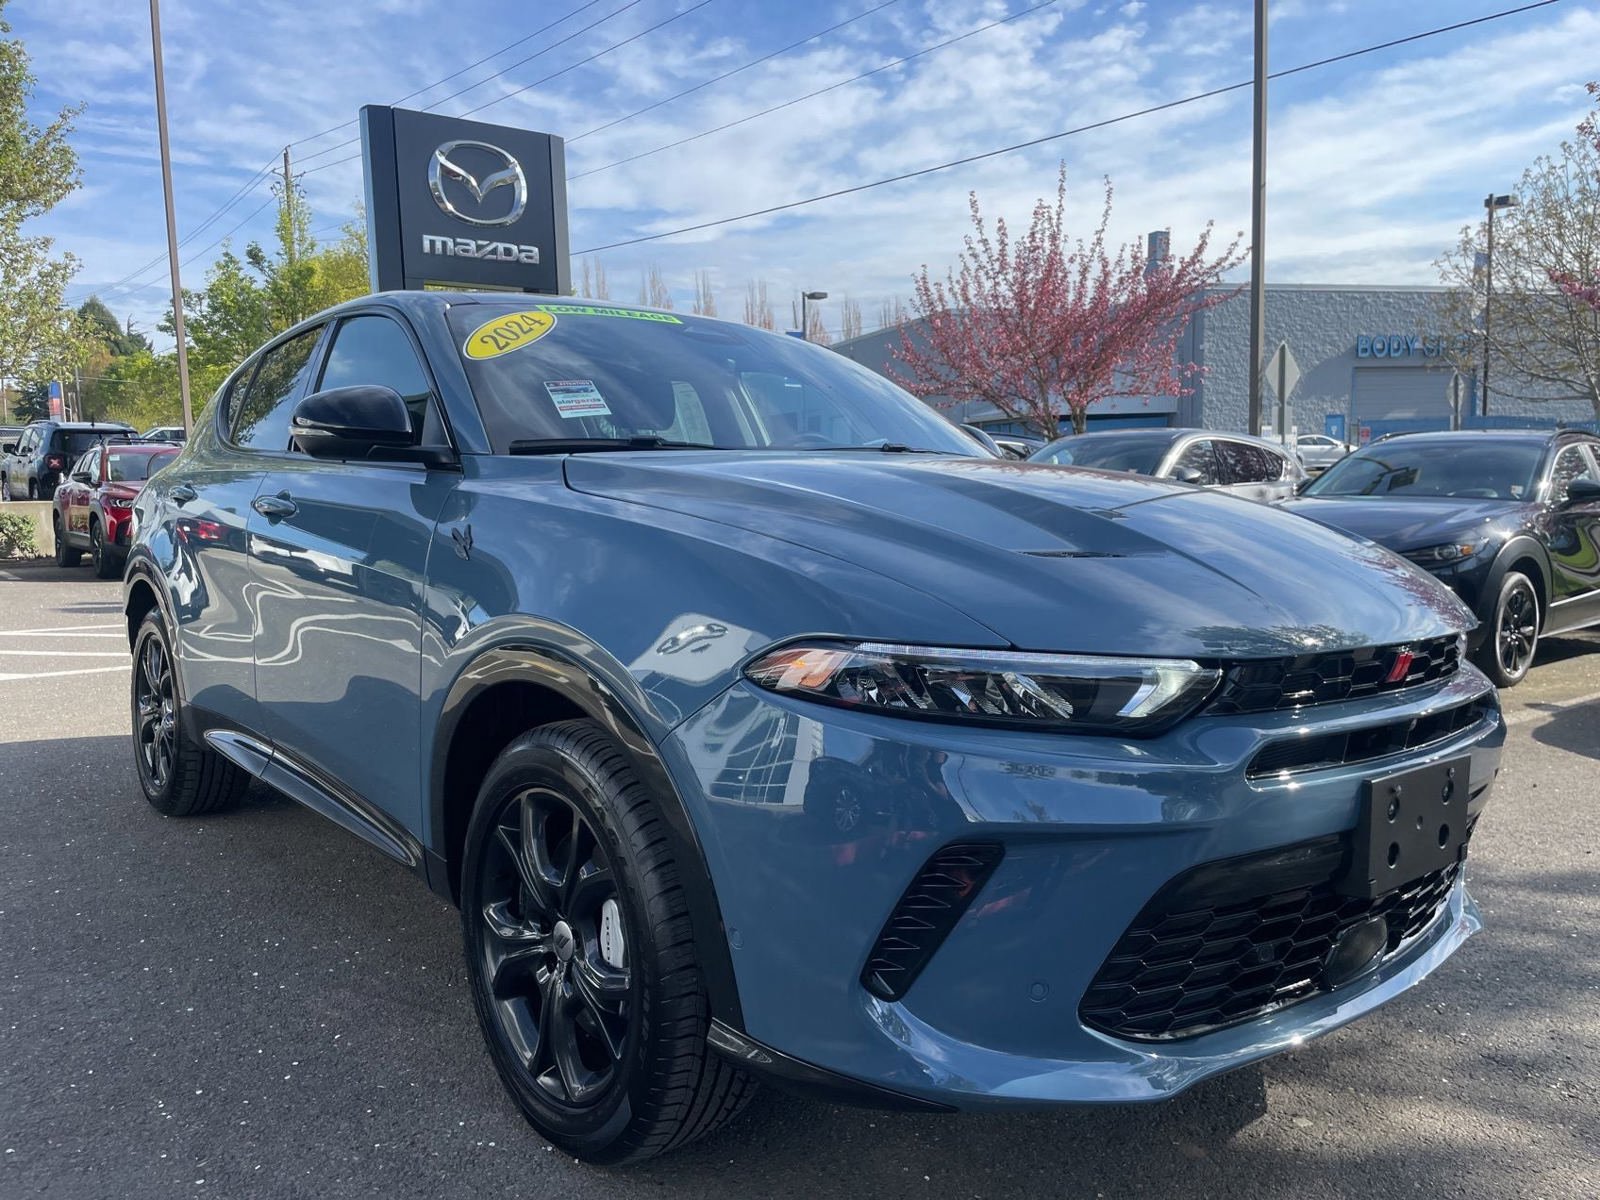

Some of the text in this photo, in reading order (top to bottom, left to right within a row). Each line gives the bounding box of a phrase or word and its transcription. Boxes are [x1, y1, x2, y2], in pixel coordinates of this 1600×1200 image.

[422, 234, 540, 265] mazda
[545, 305, 674, 321] LOW MILEAGE
[480, 314, 546, 351] 2024
[1356, 335, 1416, 358] BODY
